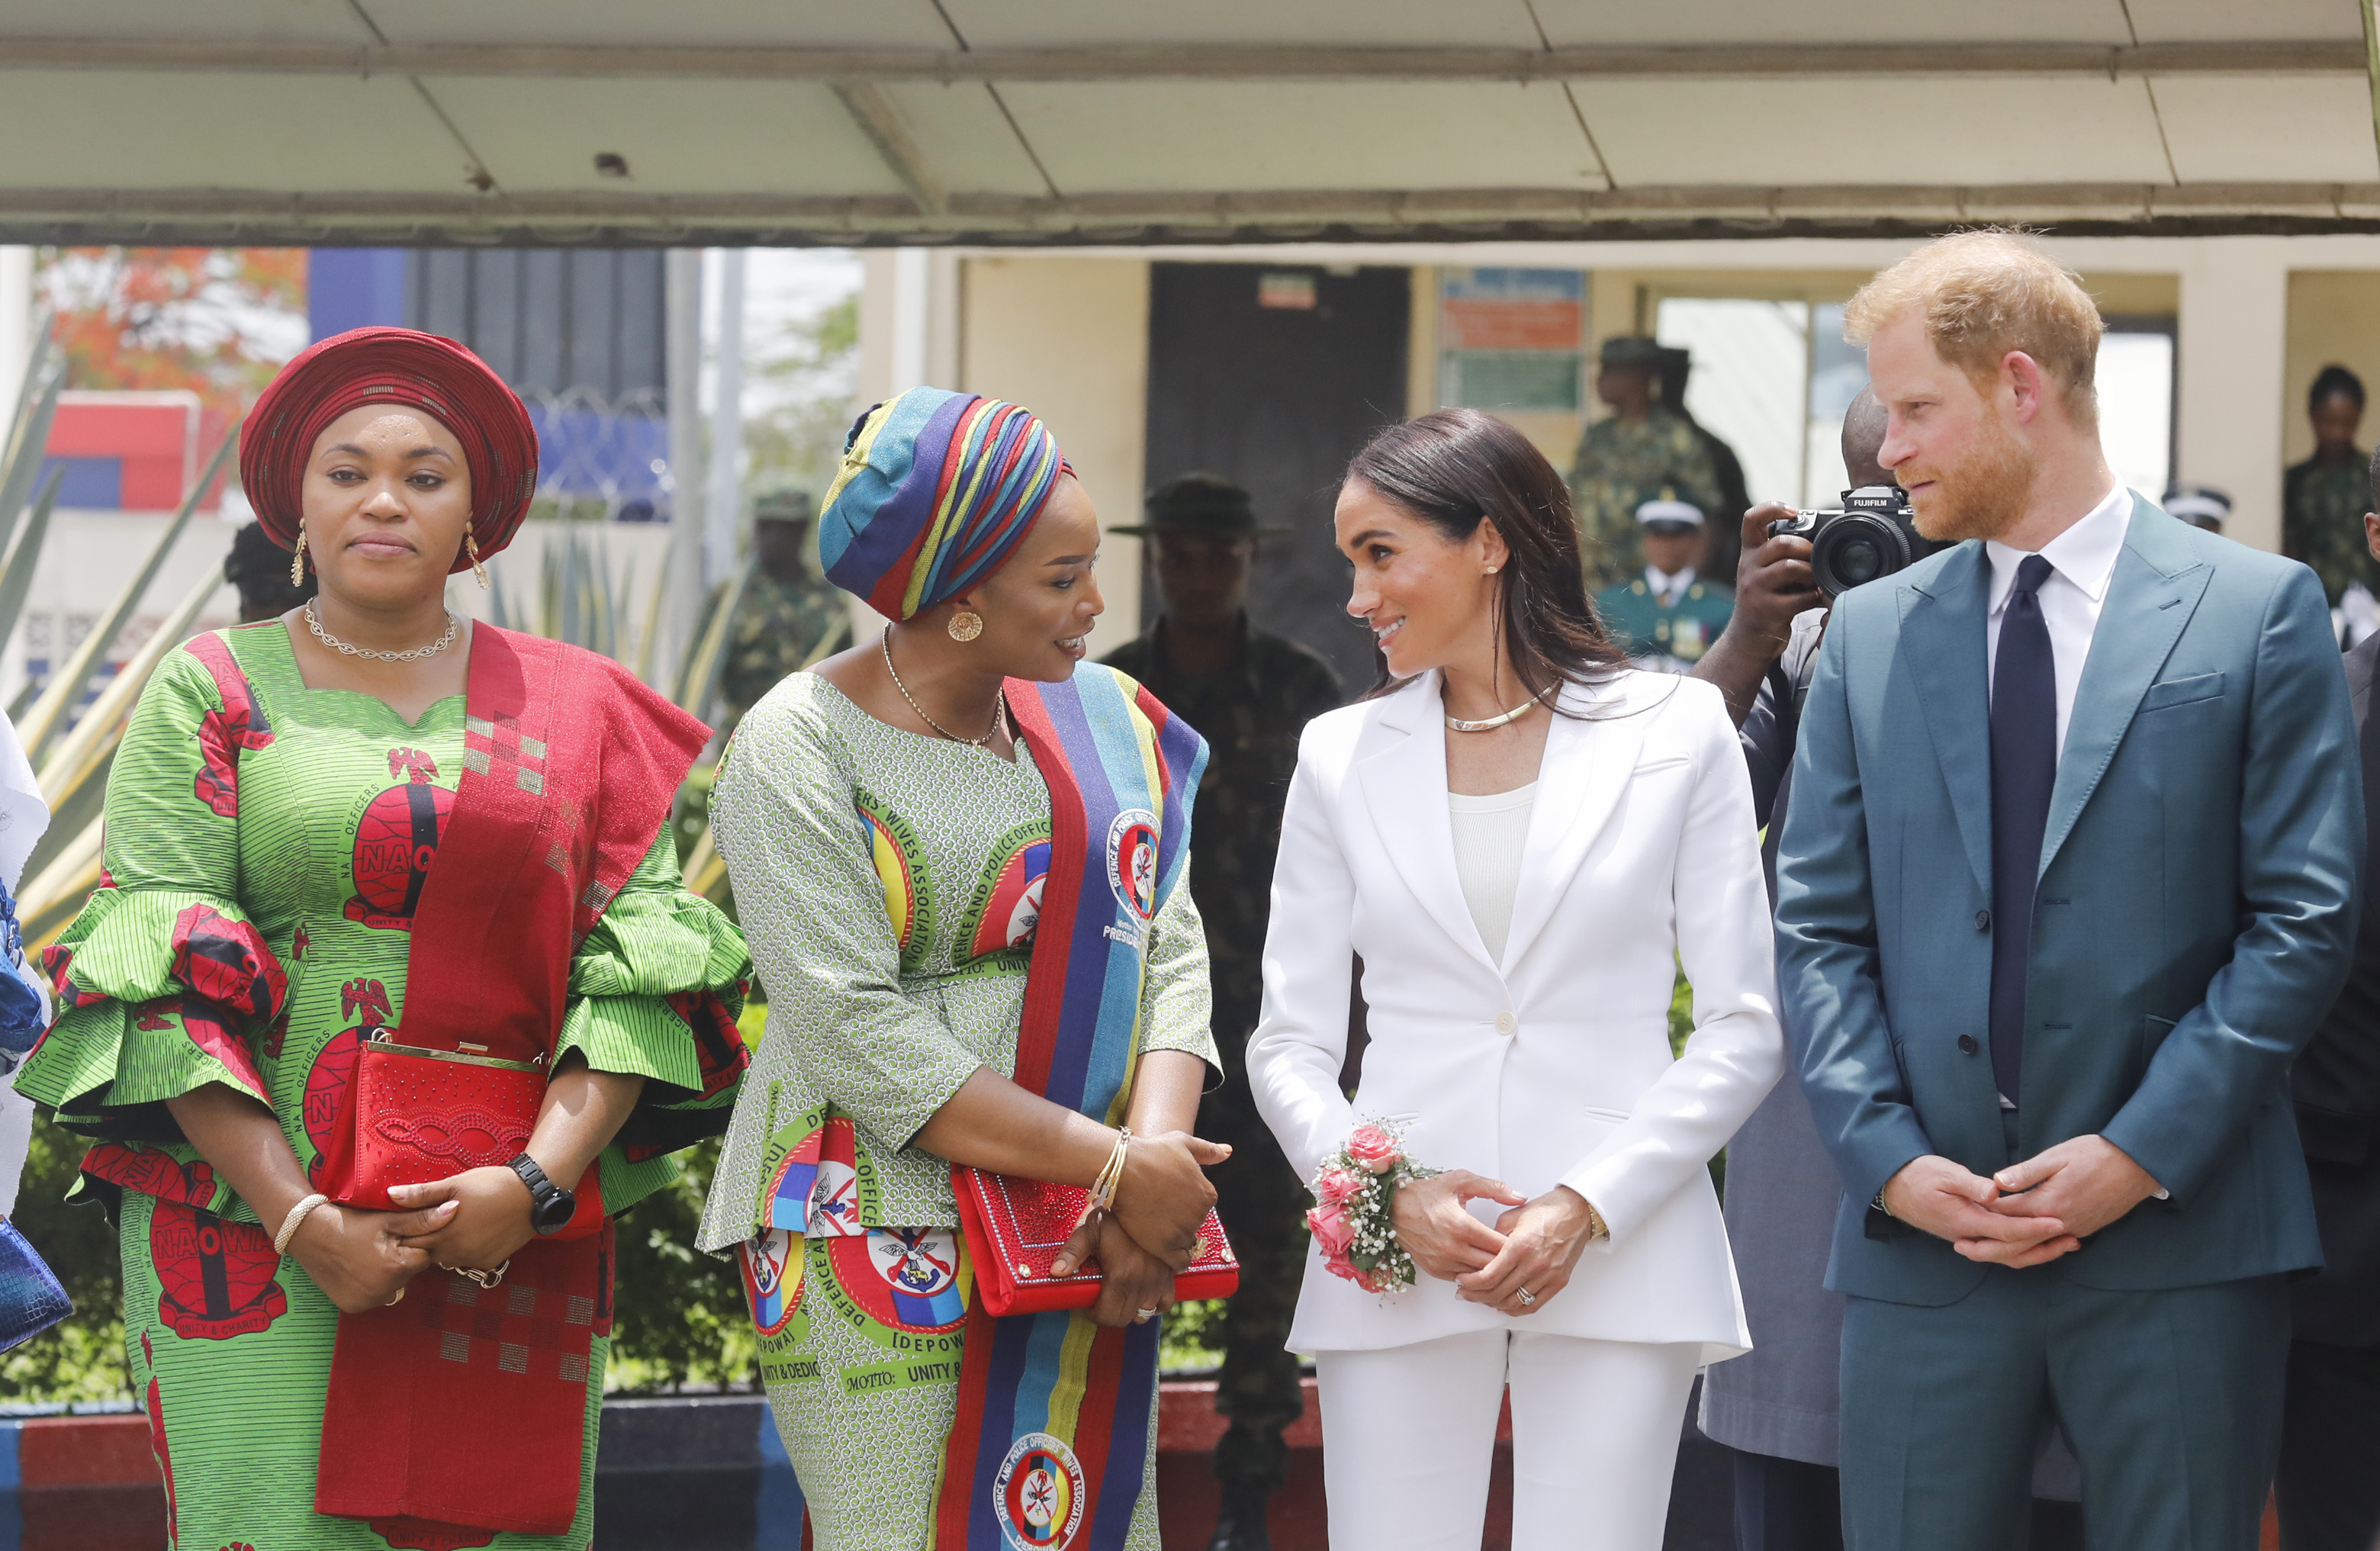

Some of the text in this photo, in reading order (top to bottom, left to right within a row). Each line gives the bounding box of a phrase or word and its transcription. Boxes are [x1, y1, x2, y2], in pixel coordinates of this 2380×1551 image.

[885, 809, 919, 860] WIVES
[909, 864, 930, 964] ASSOCIATION
[967, 884, 988, 917] AND
[983, 833, 1016, 881] POLICE
[155, 1225, 276, 1260] NAOWA
[815, 1258, 866, 1327] DEFENCE
[179, 1316, 266, 1335] UNITY & CHARITY
[846, 1372, 896, 1392] MOTTO:
[907, 1362, 950, 1382] UNITY
[1009, 1439, 1029, 1463] POLICE
[1061, 1452, 1079, 1478] WIVES
[1000, 1462, 1013, 1482] AND
[995, 1483, 1009, 1523] DEFENCE
[1063, 1479, 1082, 1537] ASSOCIATION
